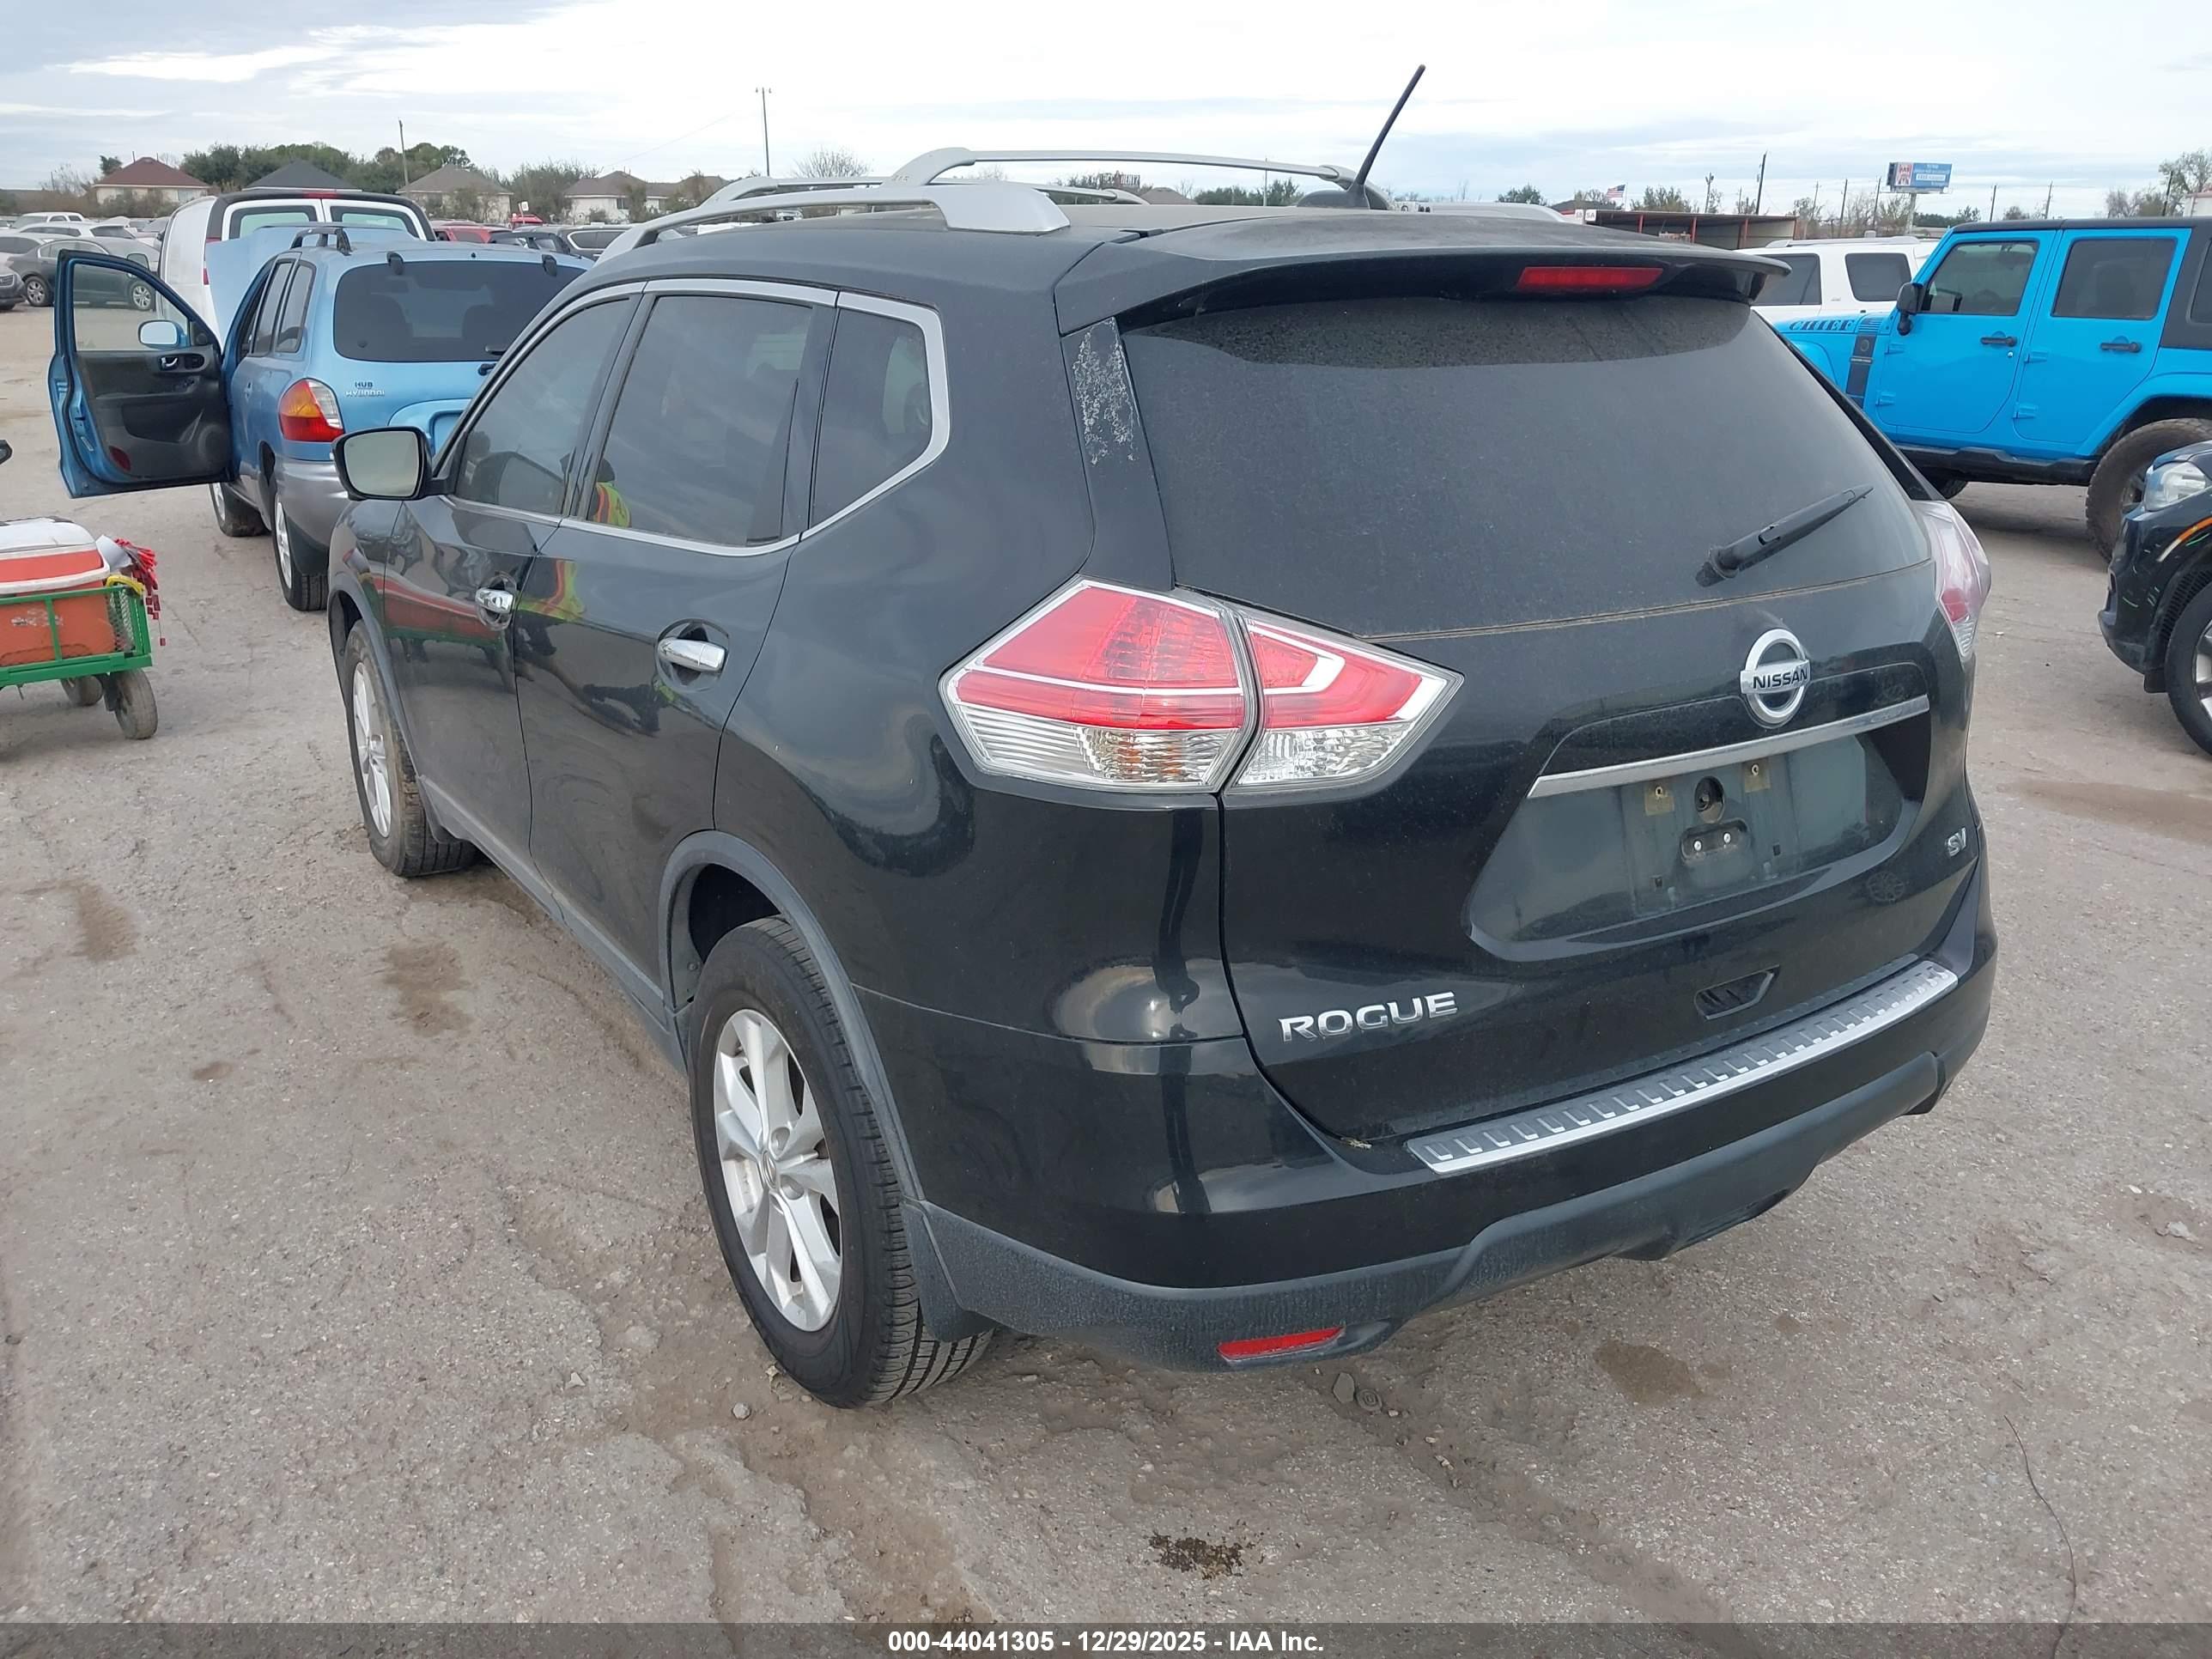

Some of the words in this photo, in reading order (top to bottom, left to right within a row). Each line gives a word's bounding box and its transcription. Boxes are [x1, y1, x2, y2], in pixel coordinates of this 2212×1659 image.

[1789, 319, 1856, 331] CHIEF
[1753, 667, 1808, 690] NISSAN
[1946, 827, 1967, 858] SV
[1278, 990, 1458, 1042] ROGUE
